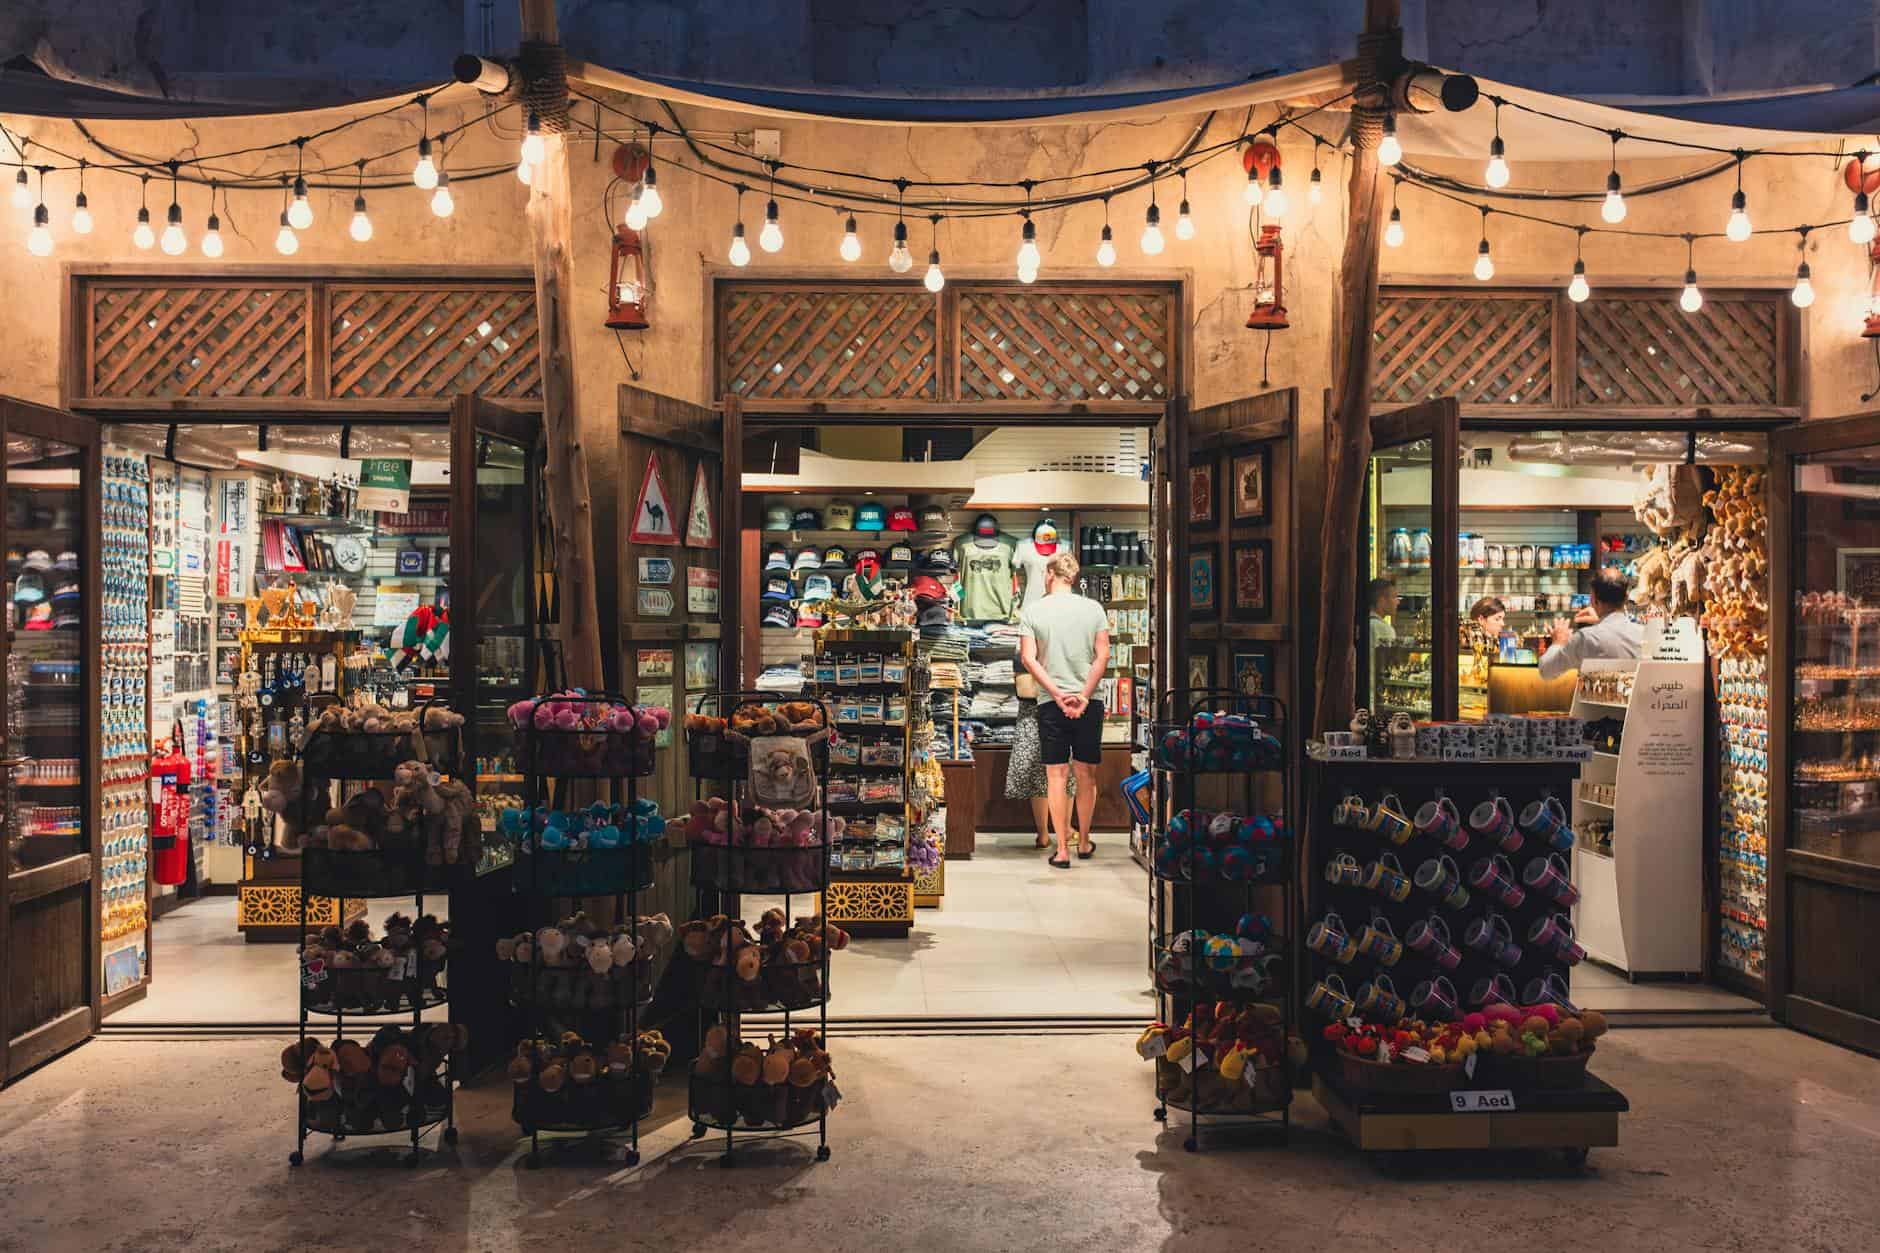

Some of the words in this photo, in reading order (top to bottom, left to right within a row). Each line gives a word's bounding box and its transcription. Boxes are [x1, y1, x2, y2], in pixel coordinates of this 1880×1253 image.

[1340, 749, 1361, 757] Aed
[1455, 749, 1476, 758] Aed
[1566, 750, 1586, 758] Aed
[1455, 1095, 1466, 1108] 9
[1478, 1095, 1509, 1107] Aed
